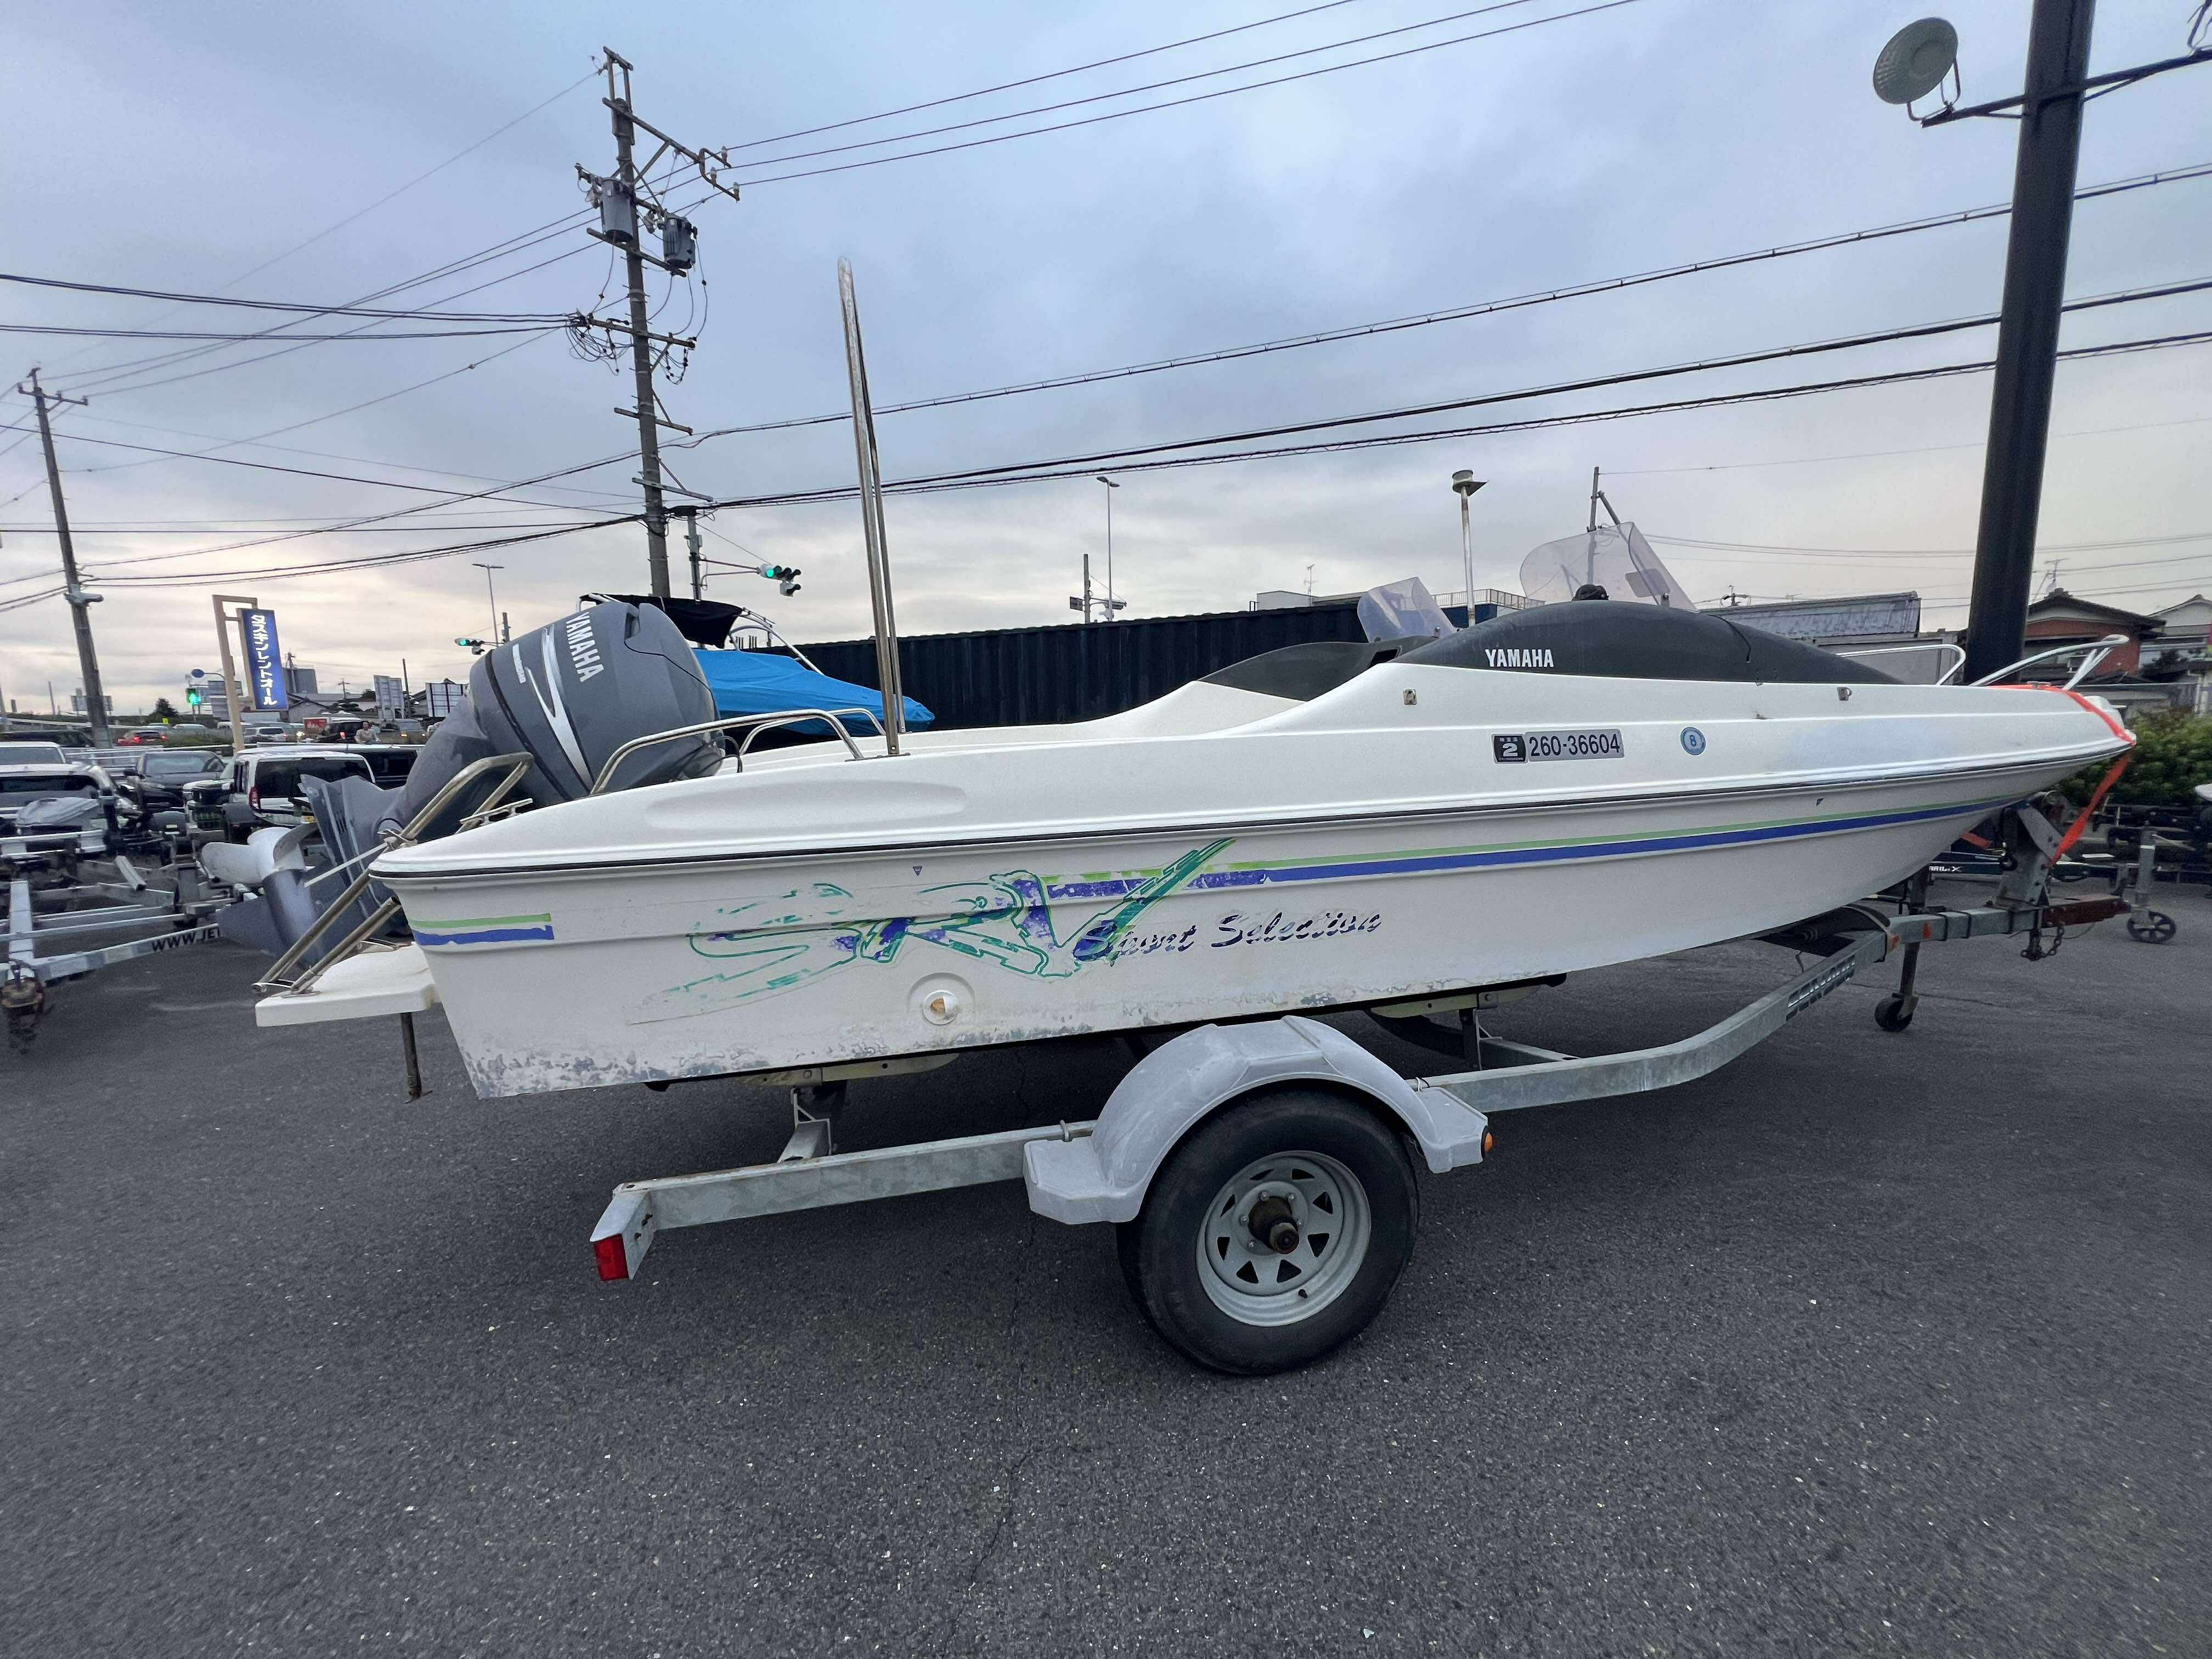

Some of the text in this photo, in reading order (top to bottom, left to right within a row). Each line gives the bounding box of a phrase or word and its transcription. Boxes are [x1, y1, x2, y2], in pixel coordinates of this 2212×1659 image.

[566, 611, 605, 682] YAMAHA
[1485, 648, 1554, 668] YAMAHA
[1502, 733, 1621, 757] 2 260-36604
